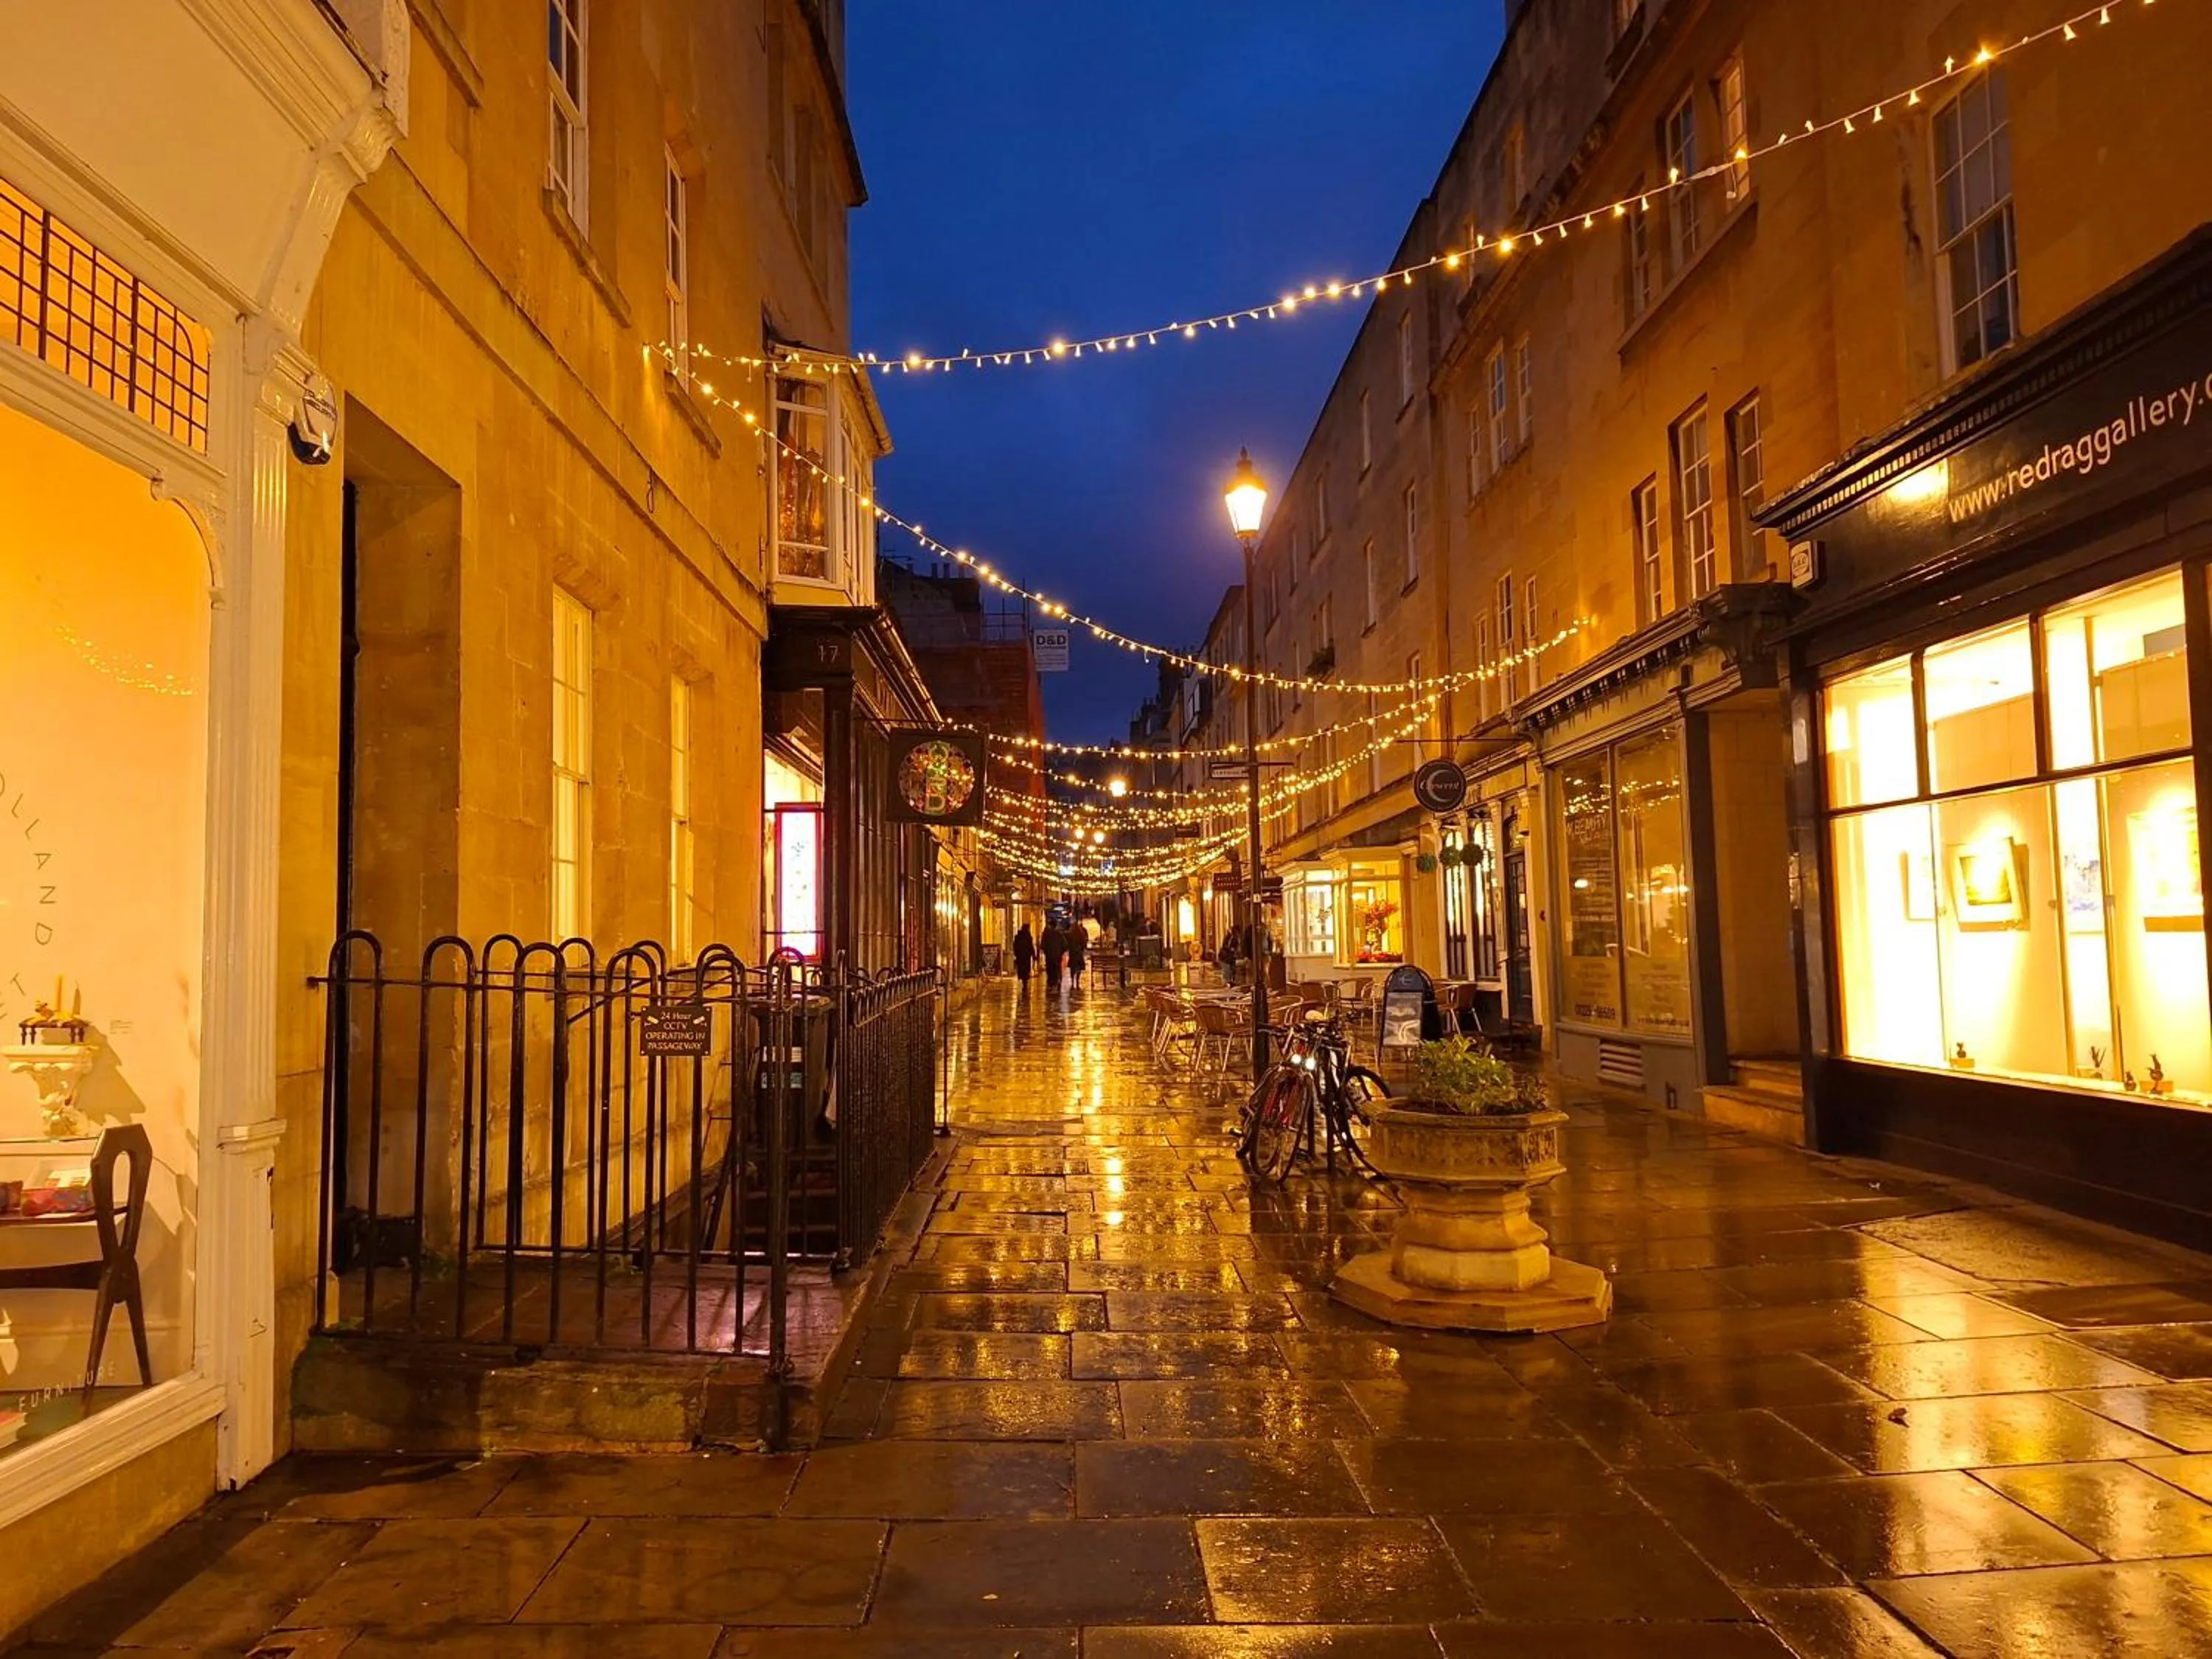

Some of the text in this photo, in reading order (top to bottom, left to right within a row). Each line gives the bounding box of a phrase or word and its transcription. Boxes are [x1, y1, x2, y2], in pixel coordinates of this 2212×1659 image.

[1036, 635, 1066, 645] D&D
[819, 644, 838, 662] 17
[664, 1021, 688, 1030] CCTV
[645, 1032, 706, 1040] OPERATING IN
[648, 1041, 702, 1050] PASSAGEWAY
[18, 1360, 116, 1412] FURNITURE
